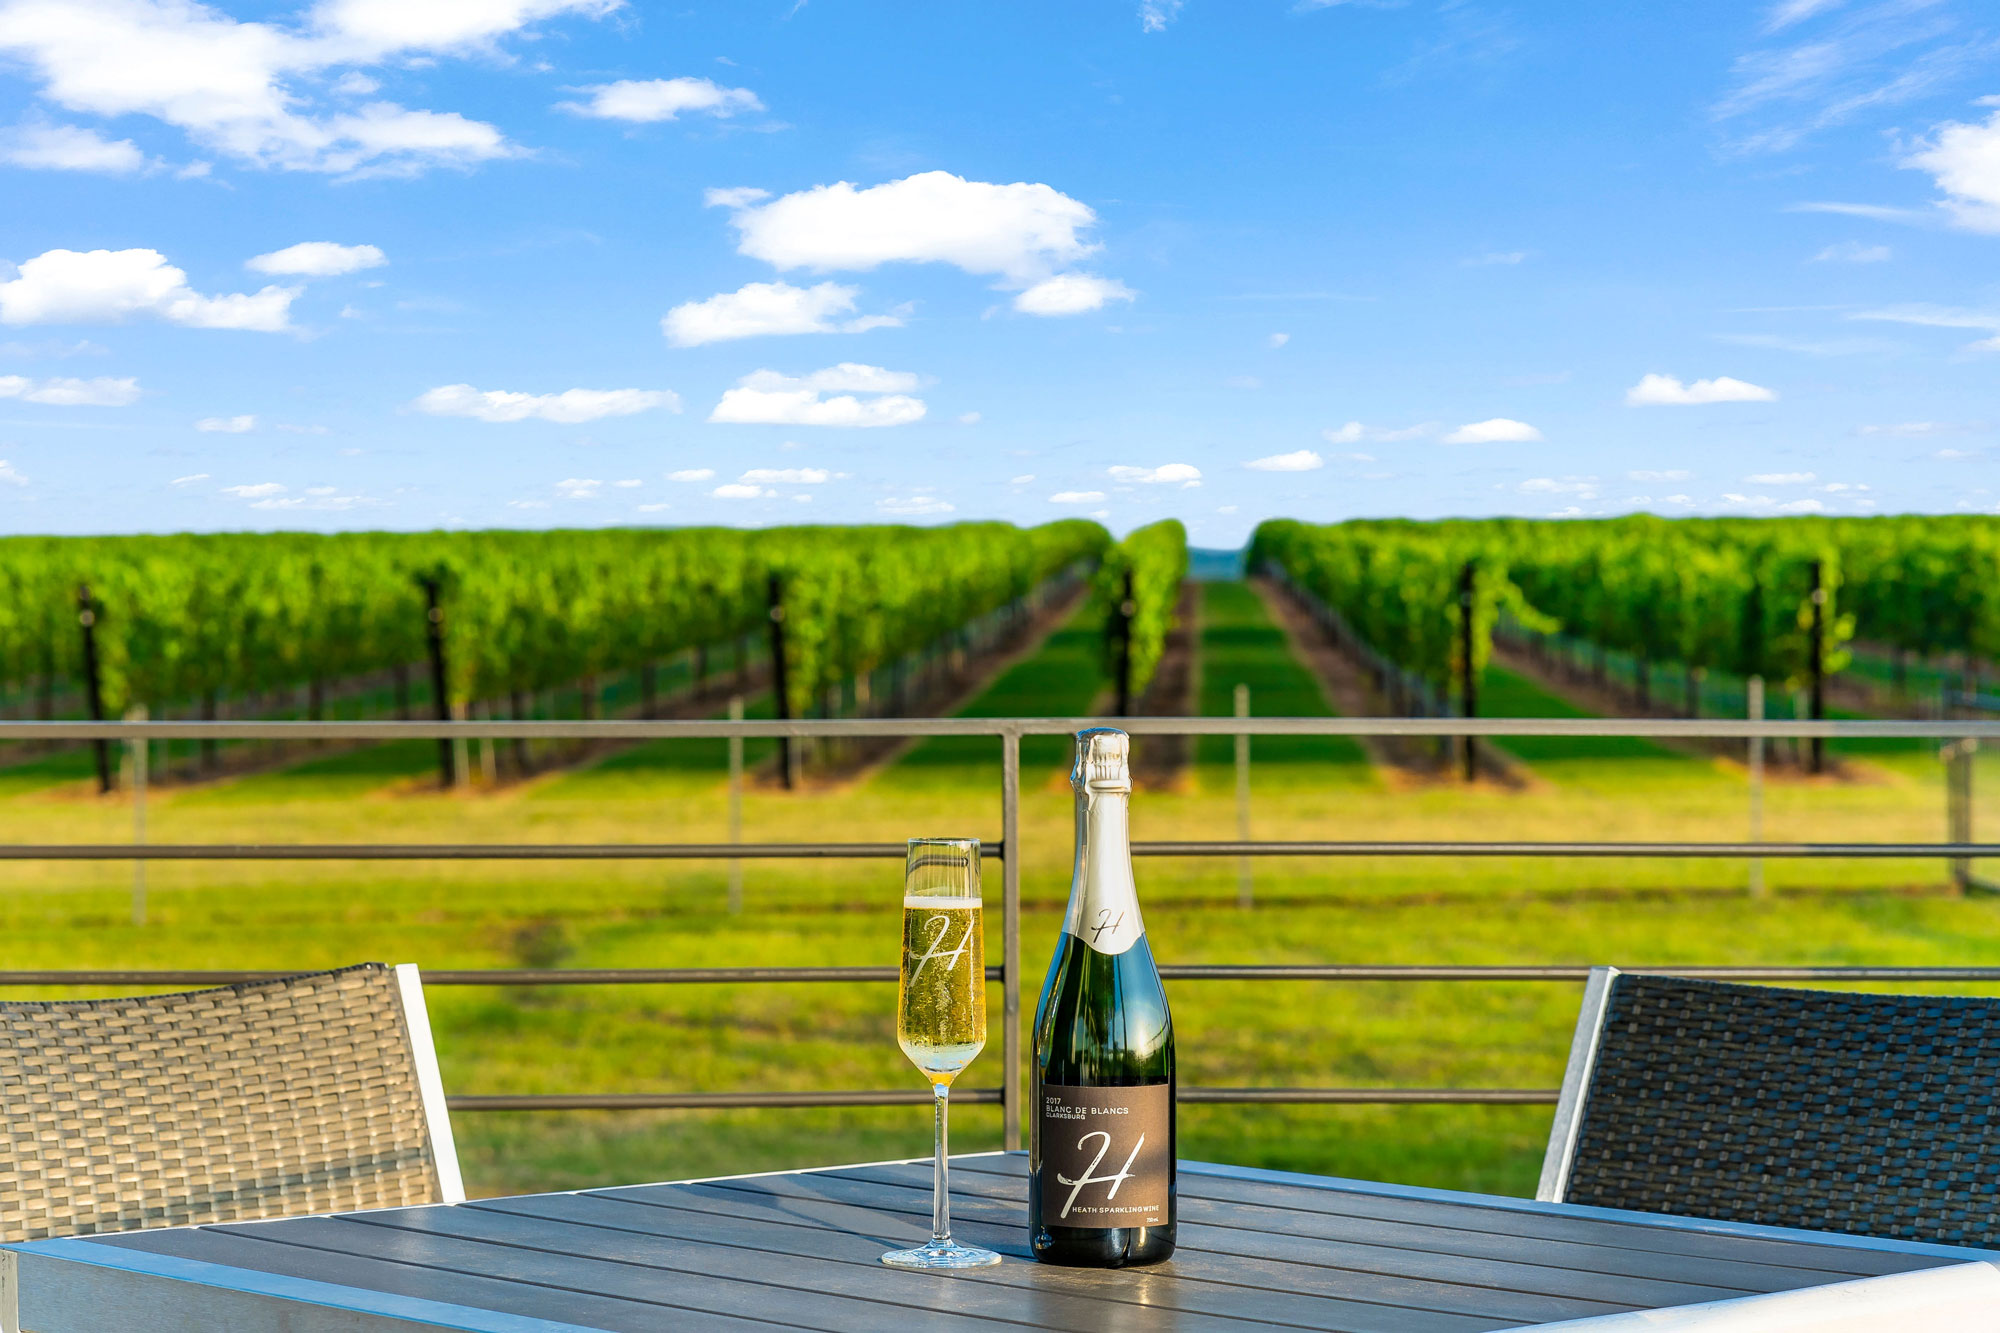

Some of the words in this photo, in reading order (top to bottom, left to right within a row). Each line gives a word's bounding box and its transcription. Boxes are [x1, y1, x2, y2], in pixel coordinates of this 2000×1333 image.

[1091, 908, 1125, 943] H
[908, 915, 975, 987] H
[1046, 1105, 1072, 1114] BLANC
[1075, 1107, 1087, 1115] DE
[1091, 1107, 1129, 1115] BLANCS
[1046, 1112, 1086, 1120] CLARKSBURG
[1057, 1131, 1145, 1219] H
[1099, 1206, 1142, 1214] SPARKLING
